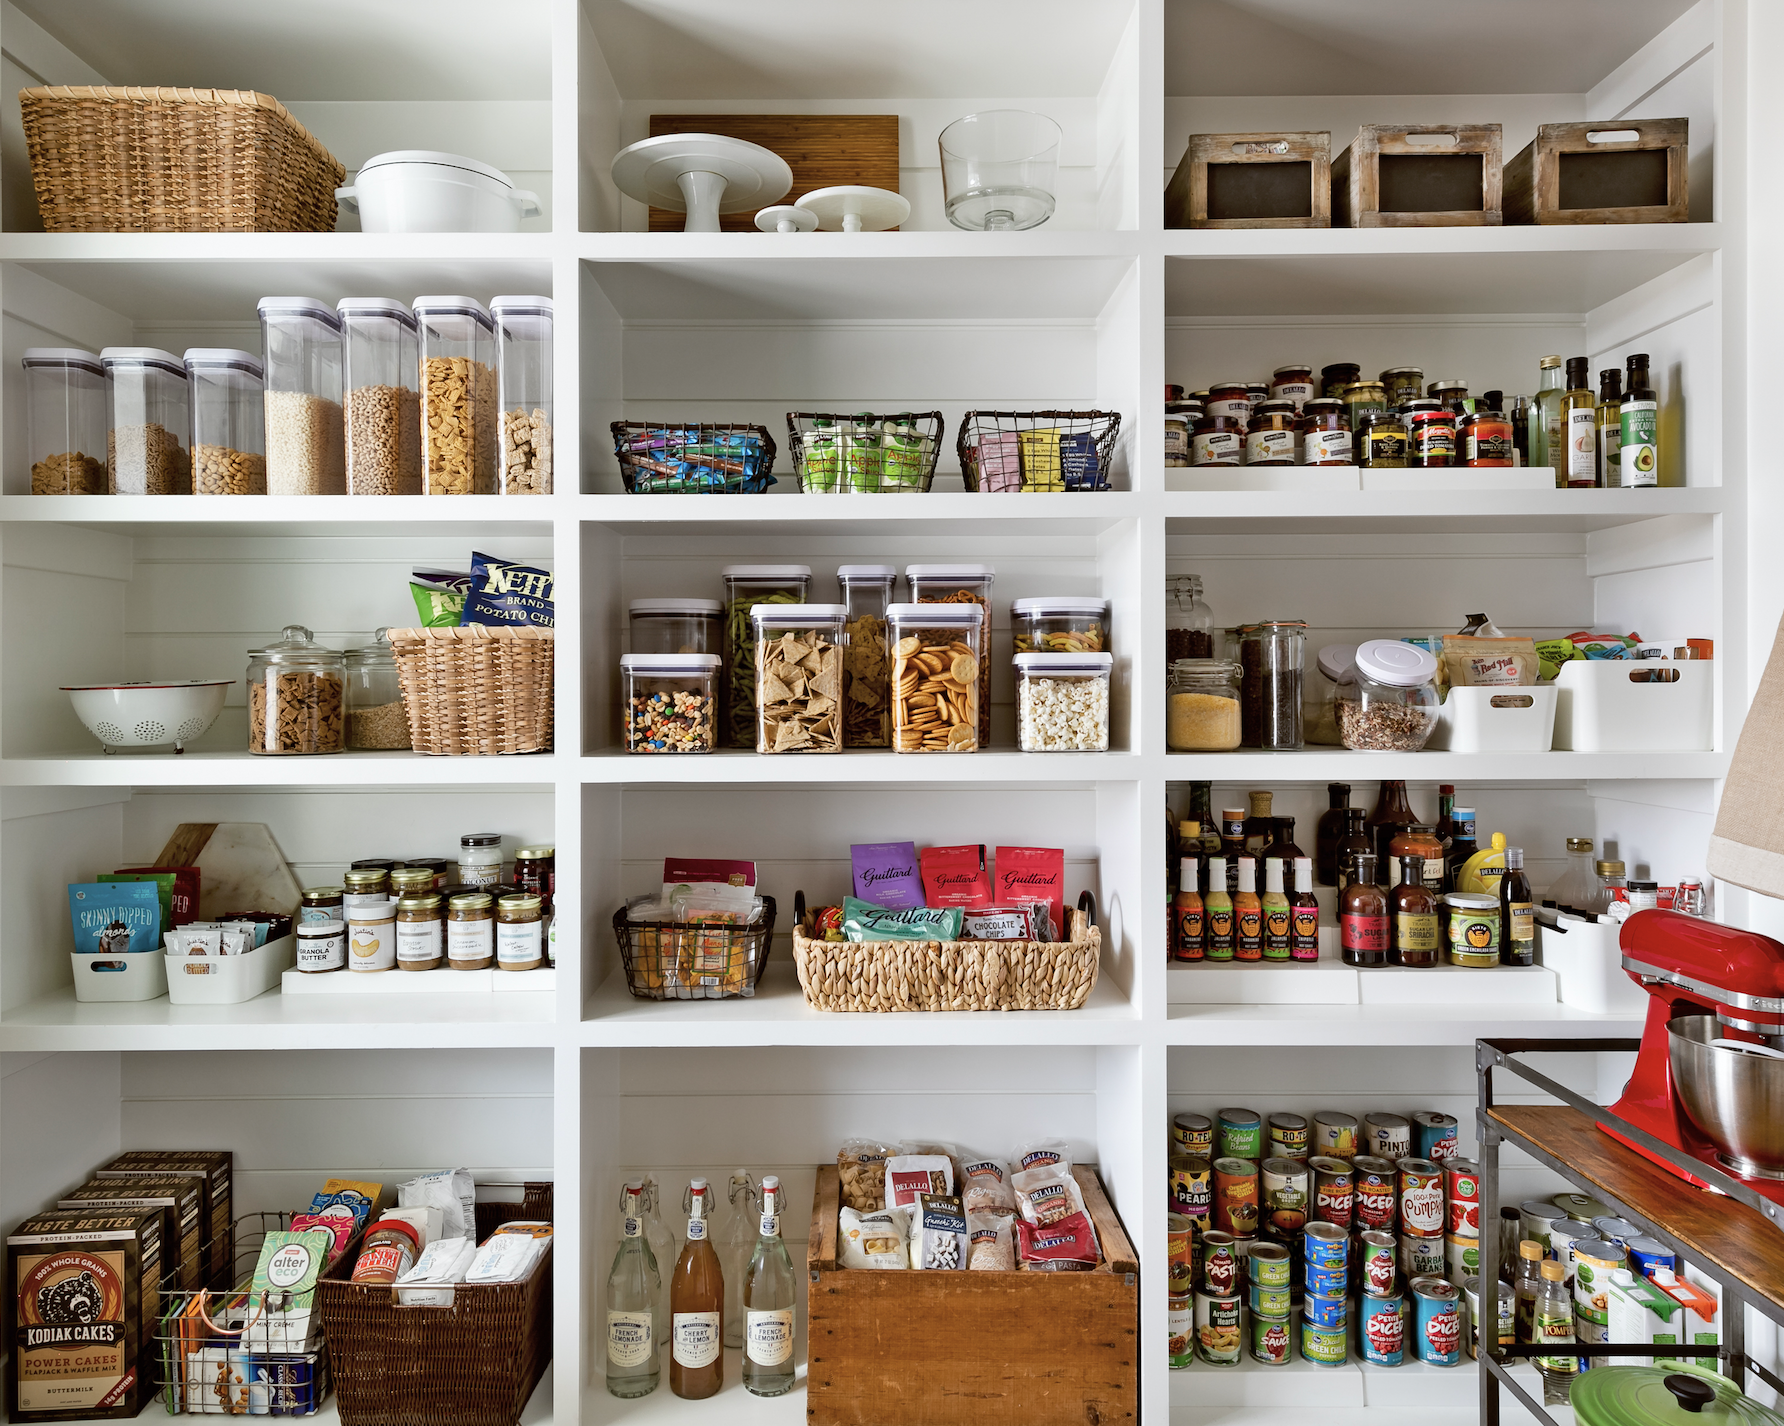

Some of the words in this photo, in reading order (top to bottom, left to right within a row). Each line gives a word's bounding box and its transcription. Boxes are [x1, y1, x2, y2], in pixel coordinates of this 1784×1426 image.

[1630, 422, 1652, 432] AVOCADO
[507, 596, 544, 609] BRAND
[475, 604, 527, 620] POTATO
[1480, 663, 1496, 675] Red
[1498, 657, 1514, 671] Mill
[860, 866, 912, 887] Guittard
[934, 873, 978, 889] Guittard
[1001, 871, 1057, 889] Guittard
[80, 907, 116, 928] SKINNY
[118, 907, 152, 926] DIPPED
[859, 906, 946, 928] Guittard
[92, 924, 136, 937] almonds
[975, 921, 1015, 930] CHOCOLATE
[986, 930, 1005, 938] CHIPS
[1228, 1133, 1254, 1145] Refried
[1022, 1152, 1058, 1166] DELALLO
[968, 1163, 1002, 1176] DELALLO
[971, 1170, 1001, 1181] ORGANIC
[88, 1178, 133, 1186] WHOLE
[139, 1177, 192, 1185] GRAINS
[895, 1182, 928, 1192] DELALLO
[1228, 1182, 1250, 1190] Organic
[119, 1189, 175, 1197] BETTER
[1030, 1186, 1063, 1200] DELALLO
[1227, 1184, 1255, 1195] Vegetarian
[1237, 1189, 1254, 1198] CHILI
[1354, 1191, 1393, 1209] DICED
[928, 1202, 957, 1211] DELALLO
[1037, 1200, 1064, 1212] ORGANIC
[23, 1220, 72, 1232] TASTE
[74, 1217, 135, 1229] BETTER
[950, 1219, 964, 1228] Kit
[40, 1234, 102, 1242] PROTEIN-PACKED
[971, 1231, 996, 1239] DELALLO
[1033, 1236, 1073, 1249] DELALLO
[274, 1257, 305, 1268] alter
[1059, 1262, 1081, 1270] PASTA
[34, 1264, 52, 1281] 100%
[52, 1258, 80, 1269] WHOLE
[81, 1259, 108, 1278] GRAINS
[276, 1268, 299, 1276] eco
[1416, 1264, 1443, 1273] BEANS
[1212, 1310, 1238, 1318] Artichoke
[1217, 1318, 1236, 1326] Hearts
[1368, 1320, 1403, 1335] DICED
[28, 1328, 72, 1345] KODIAK
[75, 1325, 114, 1341] CAKES
[1260, 1336, 1289, 1347] SAUCE
[1323, 1337, 1340, 1346] Diced
[1307, 1342, 1329, 1353] GREEN
[1330, 1344, 1345, 1353] CHILE
[25, 1358, 70, 1367] POWER
[75, 1355, 117, 1365] CAKES
[104, 1391, 116, 1404] 14g
[113, 1375, 134, 1396] PROTEIN
